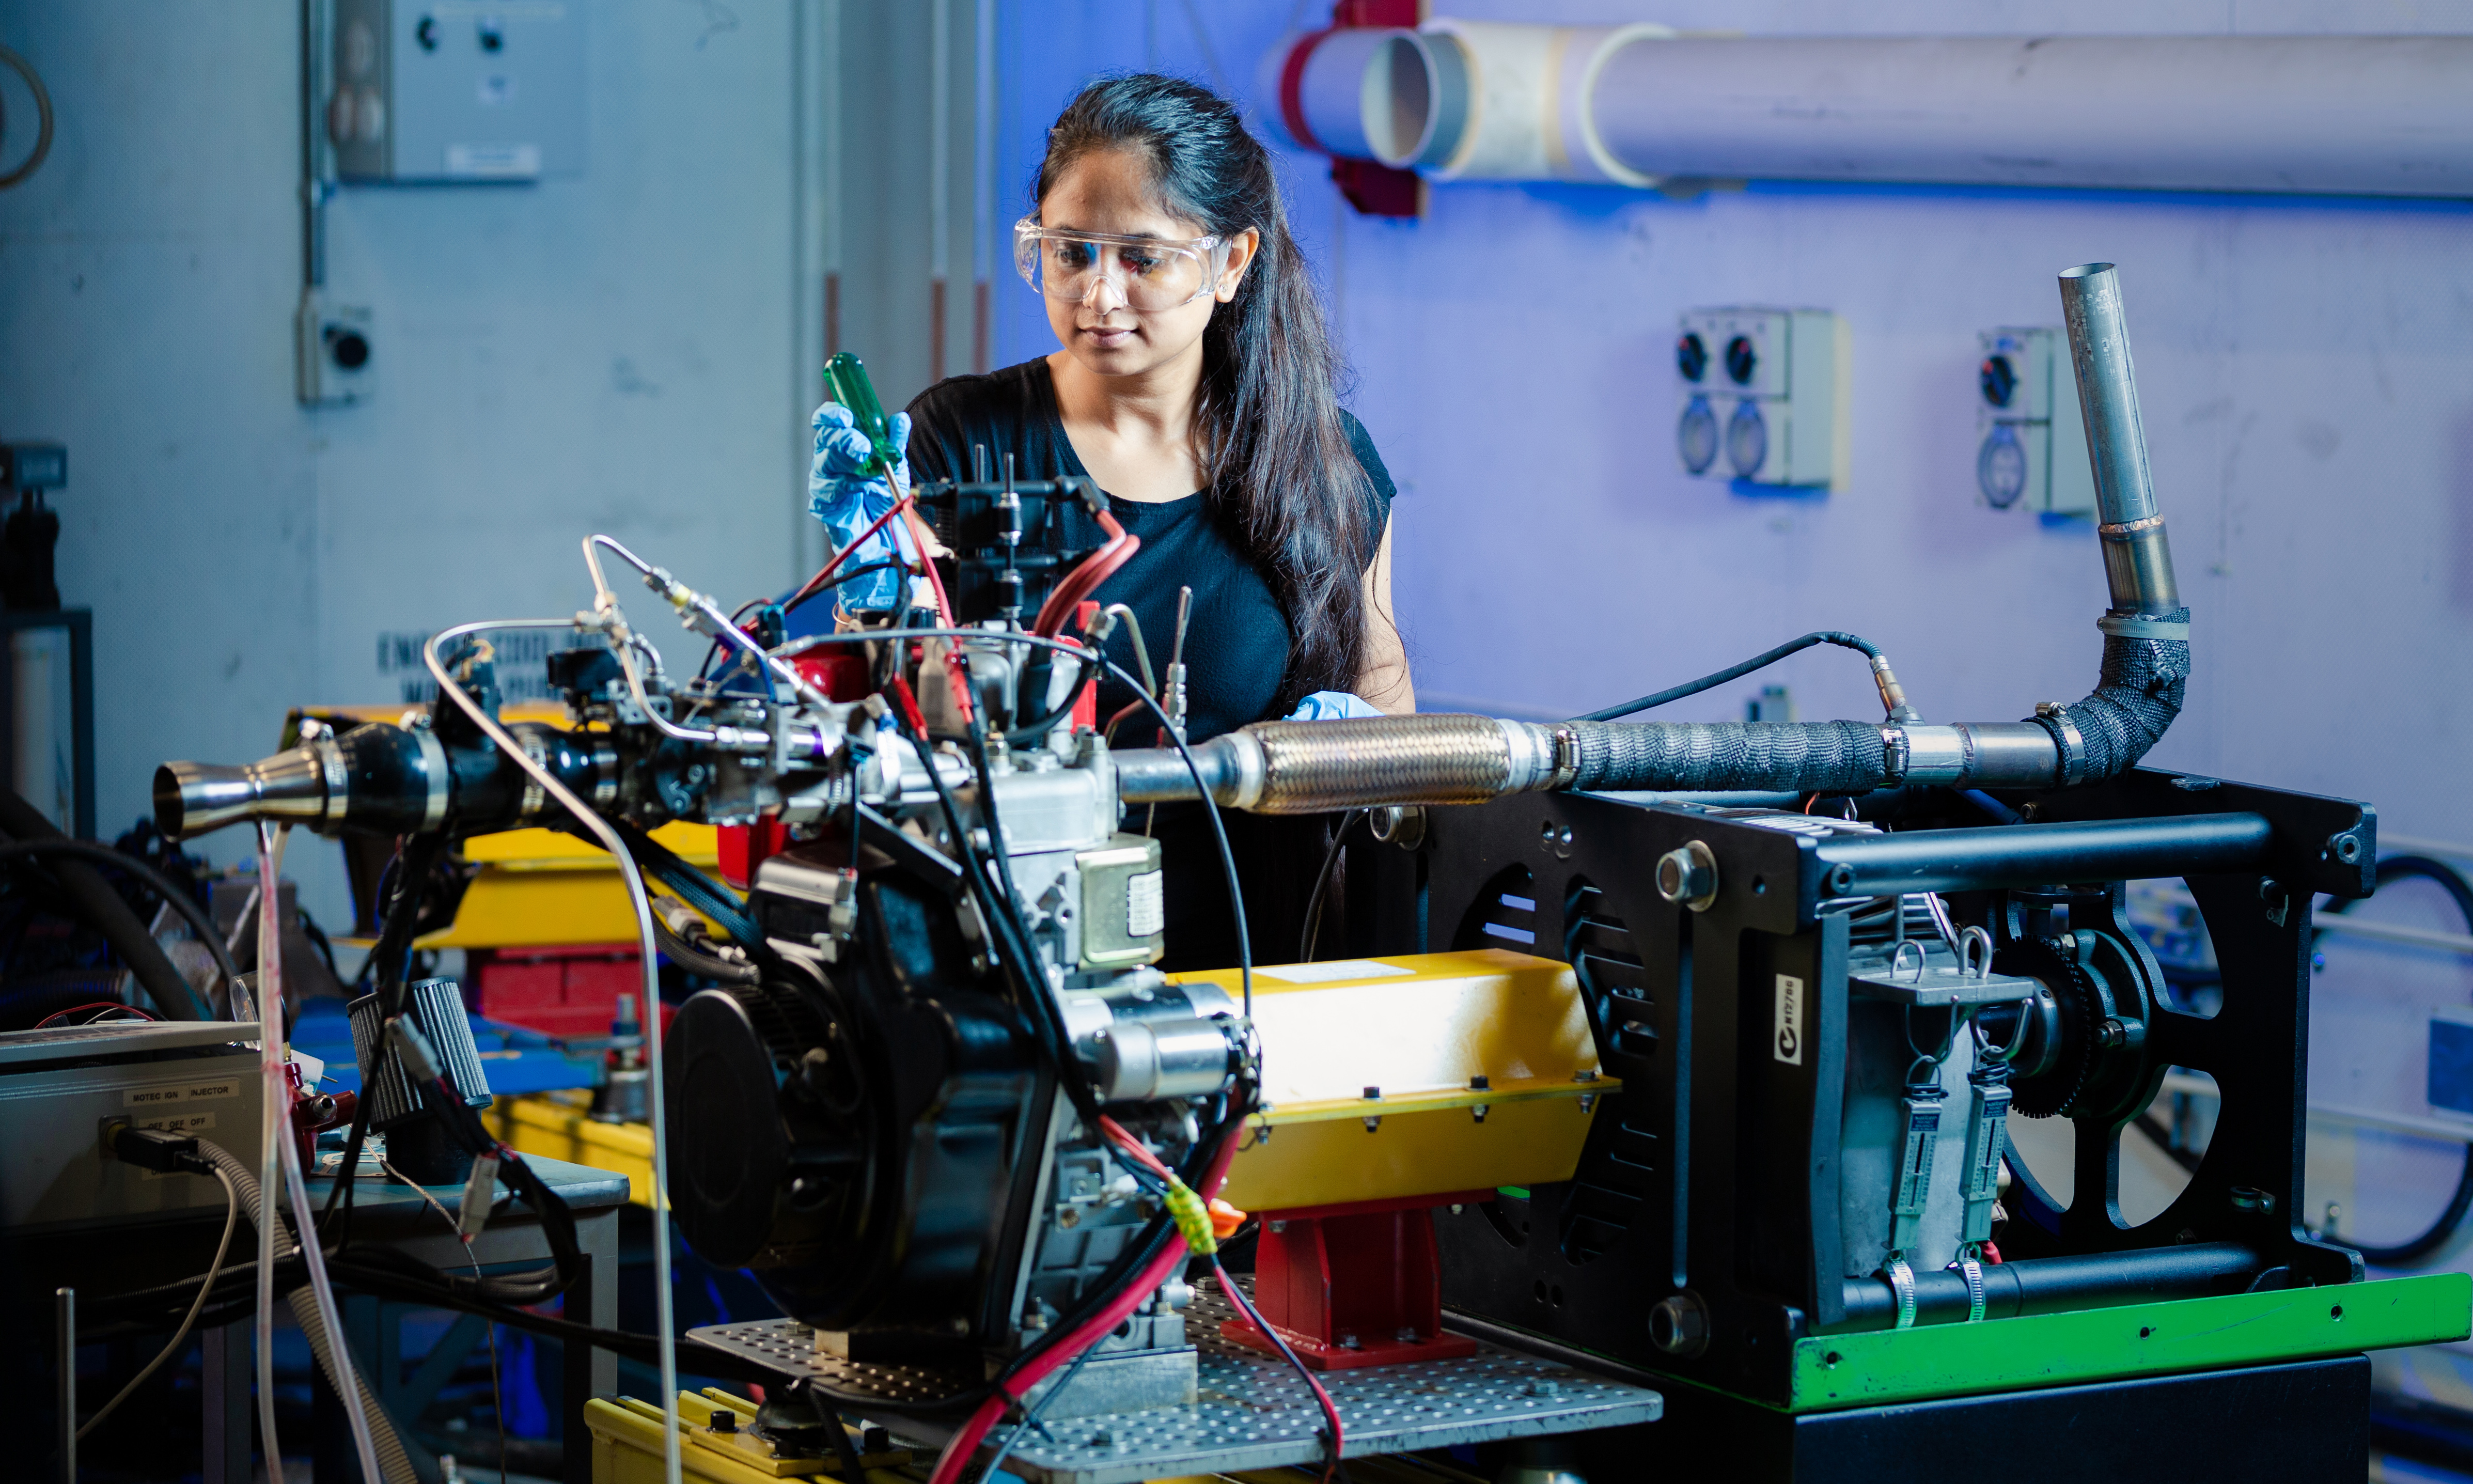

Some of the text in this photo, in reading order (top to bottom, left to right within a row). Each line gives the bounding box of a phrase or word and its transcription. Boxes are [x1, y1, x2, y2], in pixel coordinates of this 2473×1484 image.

[133, 1092, 161, 1102] MOTEC
[191, 1086, 229, 1097] INJECTOR
[148, 1117, 206, 1130] OFF OFF OFF
